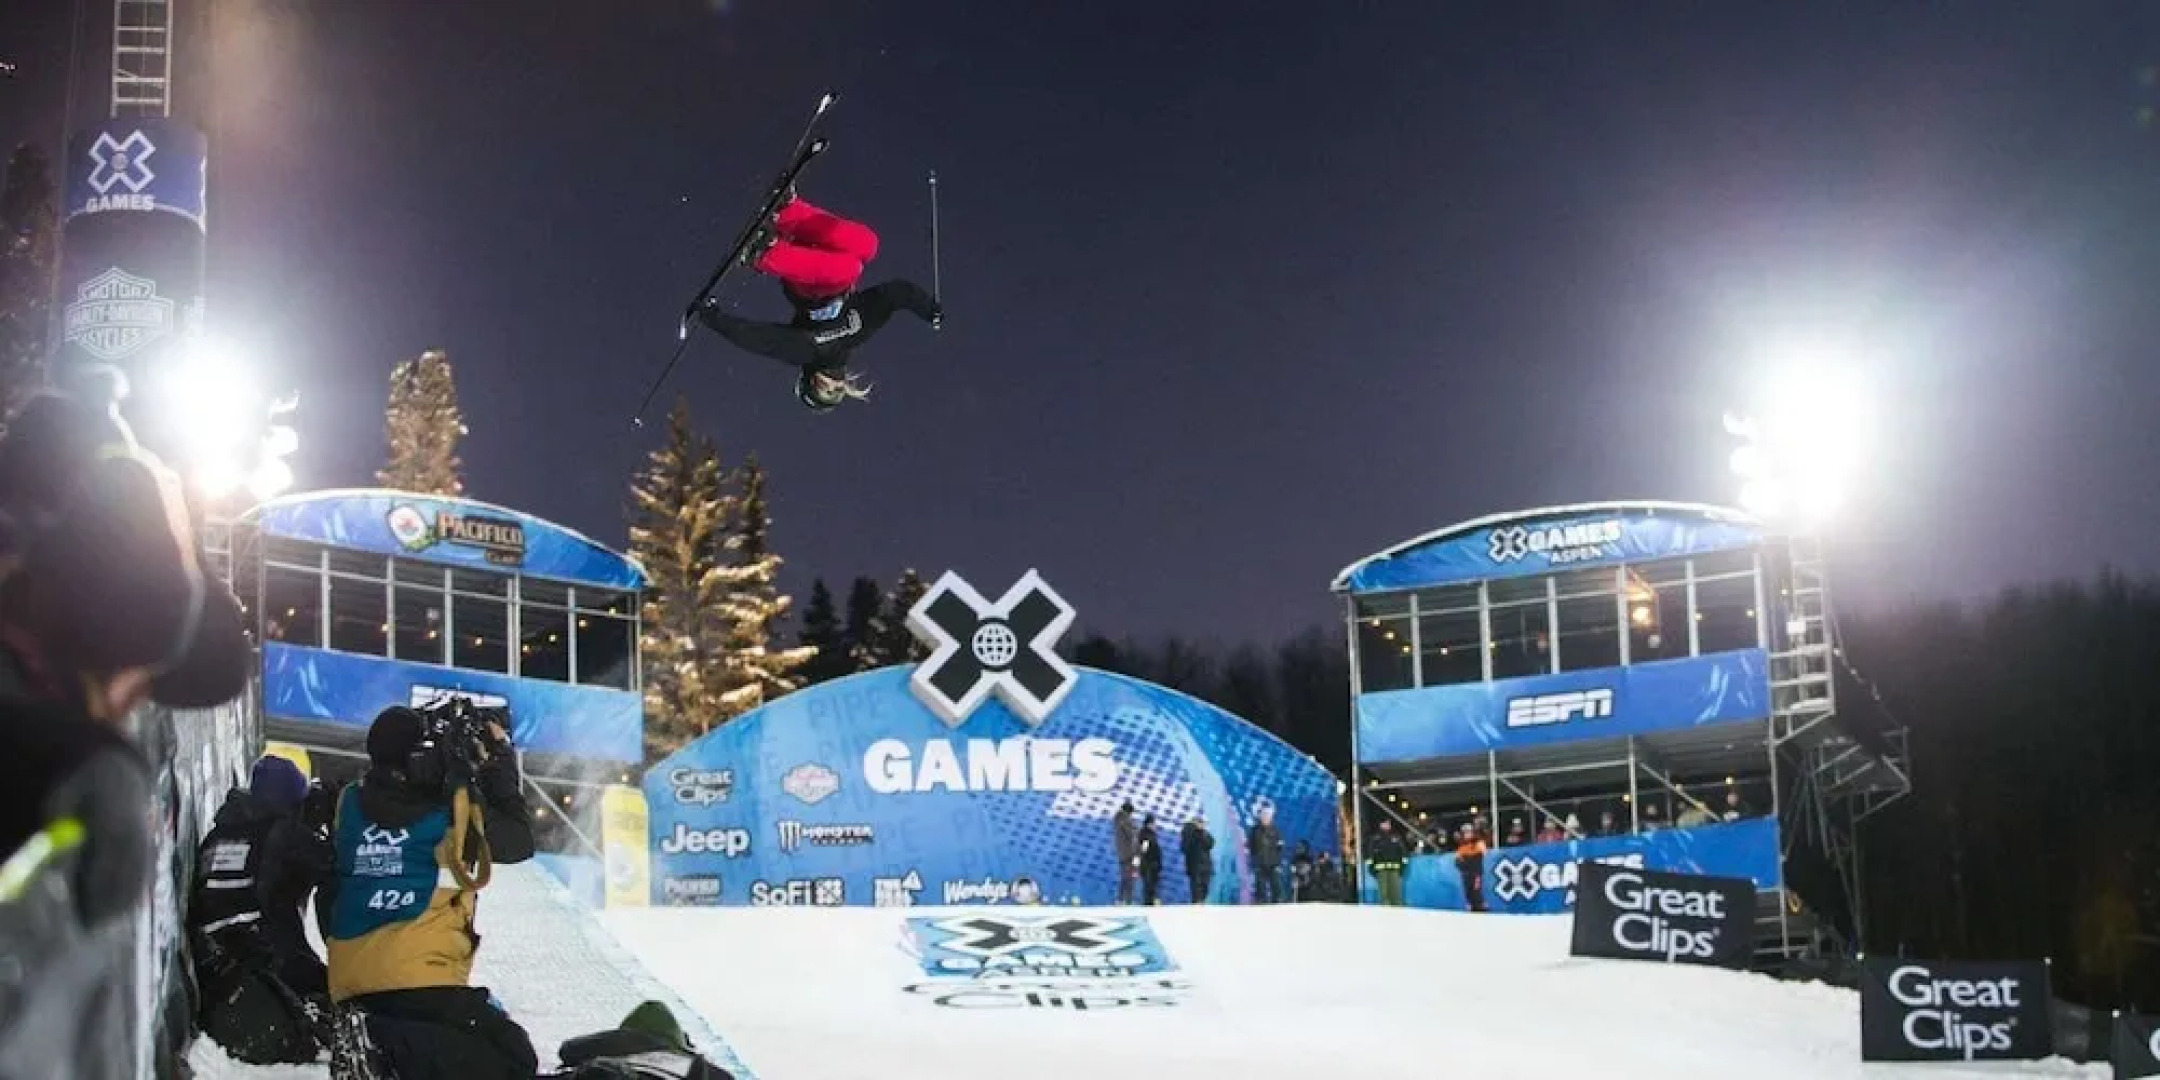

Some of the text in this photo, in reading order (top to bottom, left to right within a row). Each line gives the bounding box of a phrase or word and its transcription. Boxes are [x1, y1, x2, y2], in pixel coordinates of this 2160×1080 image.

[86, 193, 155, 212] GAMES
[1528, 520, 1621, 551] GAMES
[1551, 545, 1602, 562] ASPEN
[1507, 689, 1612, 727] ESPN
[670, 768, 734, 786] Great
[863, 737, 1118, 794] GAMES
[675, 787, 732, 807] Clips
[661, 822, 750, 857] Jeep
[1604, 872, 1725, 920] Great
[1889, 965, 2020, 1007] Great
